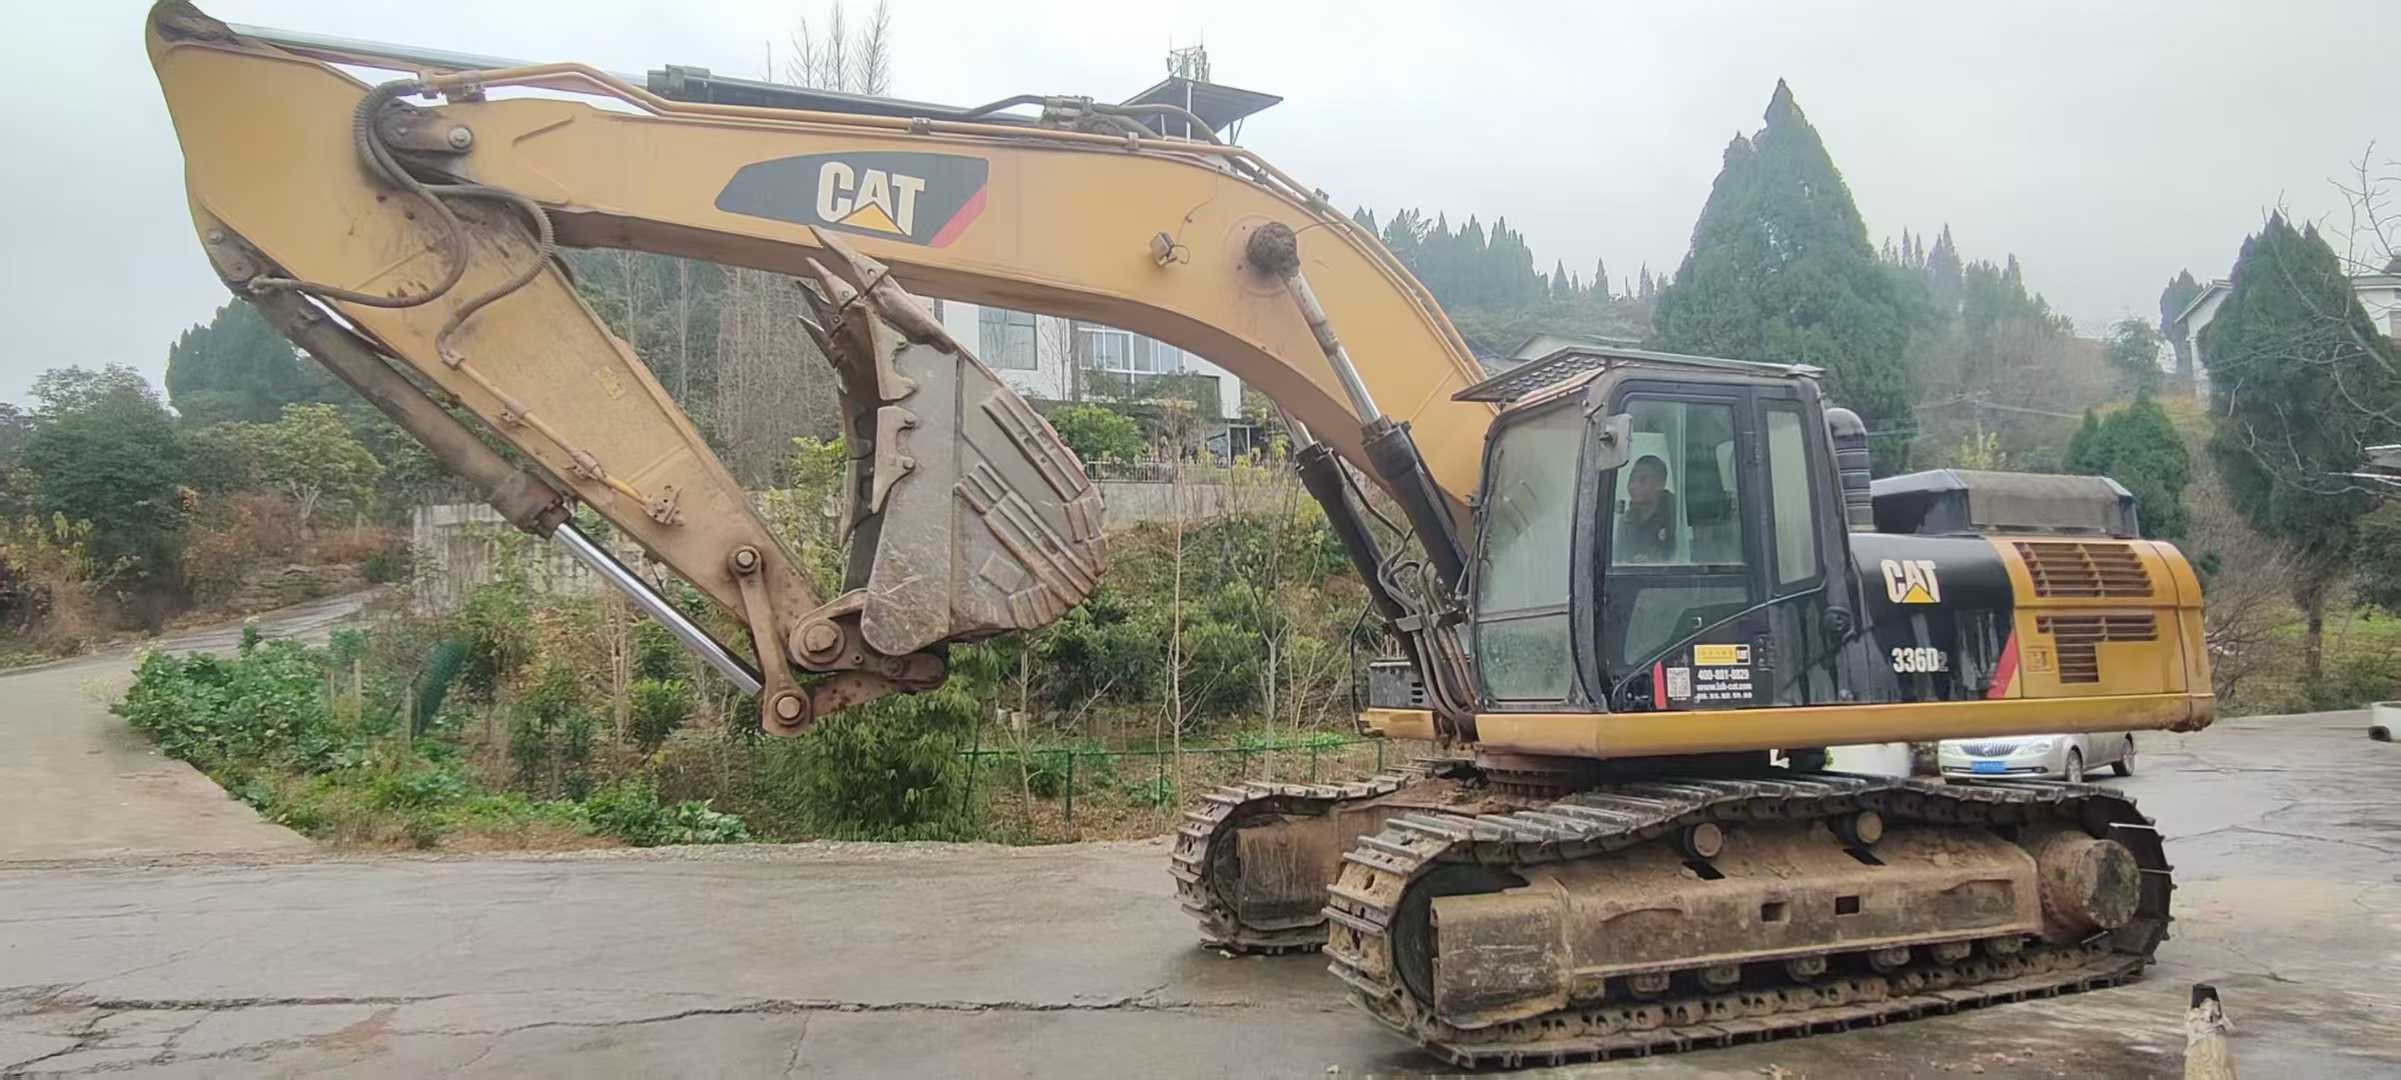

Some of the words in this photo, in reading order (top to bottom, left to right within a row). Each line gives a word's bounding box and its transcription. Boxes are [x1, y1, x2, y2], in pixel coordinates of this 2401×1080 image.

[816, 161, 926, 237] CAT
[1880, 559, 1942, 604] CAT
[1891, 646, 1950, 673] 336D2
